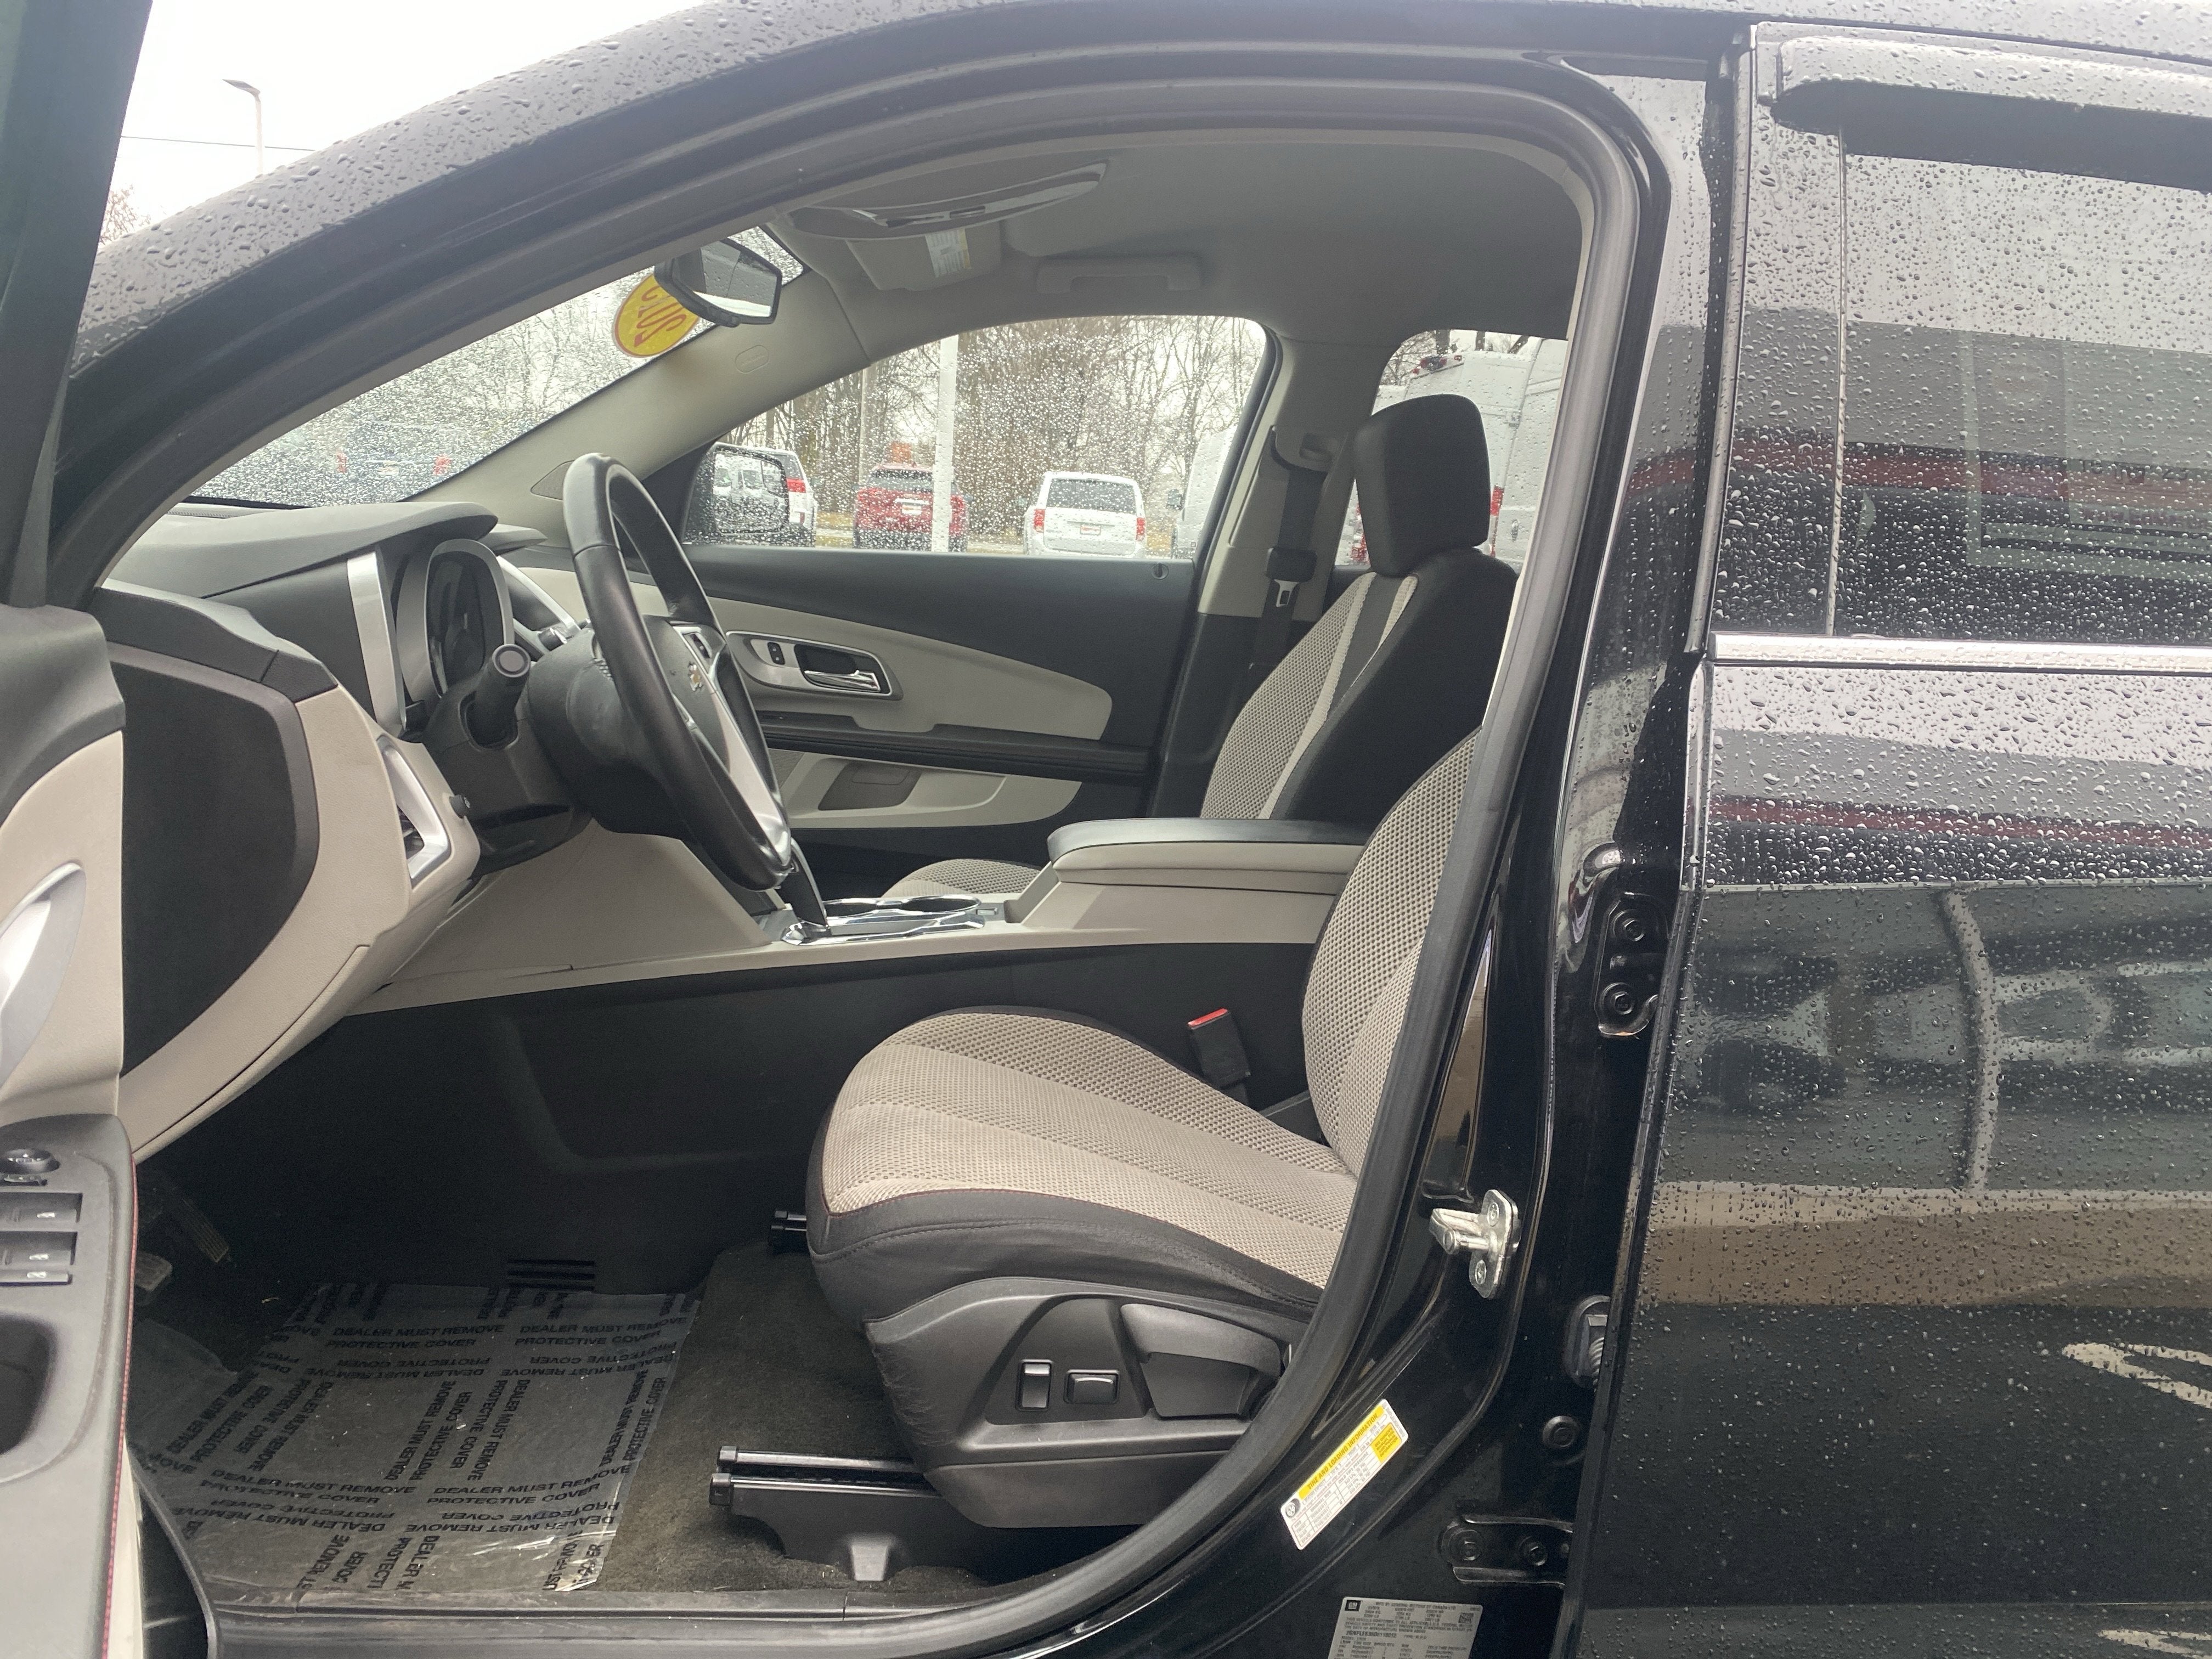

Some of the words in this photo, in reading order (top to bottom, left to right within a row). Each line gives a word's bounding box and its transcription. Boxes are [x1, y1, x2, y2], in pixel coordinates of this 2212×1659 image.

[519, 1324, 578, 1334] DEALER
[582, 1324, 623, 1334] MUST
[626, 1317, 687, 1331] REMOVE
[514, 1336, 607, 1346] PROTECTIVE
[612, 1329, 662, 1344] COVER
[499, 1368, 566, 1376] REMOVE
[529, 1356, 582, 1365] COVER
[469, 1379, 508, 1432] PROTECTIVE
[503, 1379, 531, 1412] DEALER
[489, 1413, 515, 1440] MUST
[622, 1408, 656, 1461] PROTECTIVE
[645, 1376, 668, 1405] COVER
[384, 1446, 418, 1480] DEALER
[409, 1426, 454, 1481] PROTECTIVE
[450, 1436, 478, 1469] COVER
[466, 1441, 500, 1481] REMOVE
[1306, 1475, 1319, 1491] TIRE
[1317, 1465, 1329, 1480] AND
[1327, 1444, 1349, 1469] LOADING
[1346, 1412, 1379, 1448] INFORMATION
[211, 1469, 283, 1486] DEALER
[285, 1480, 337, 1492] MUST
[339, 1483, 416, 1494] REMOVE
[433, 1486, 504, 1494] DEALER
[507, 1482, 559, 1493] MUST
[560, 1463, 632, 1489] REMOVE
[317, 1493, 382, 1504] COVER
[425, 1496, 537, 1504] PROTECTIVE
[540, 1482, 601, 1502] COVER
[253, 1513, 309, 1527] MUST
[280, 1504, 396, 1520] PROTECTIVE
[441, 1511, 505, 1521] COVER
[311, 1519, 387, 1533] DEALER
[404, 1523, 484, 1532] REMOVE
[486, 1522, 541, 1533] MUST
[405, 1536, 441, 1577] DEALER
